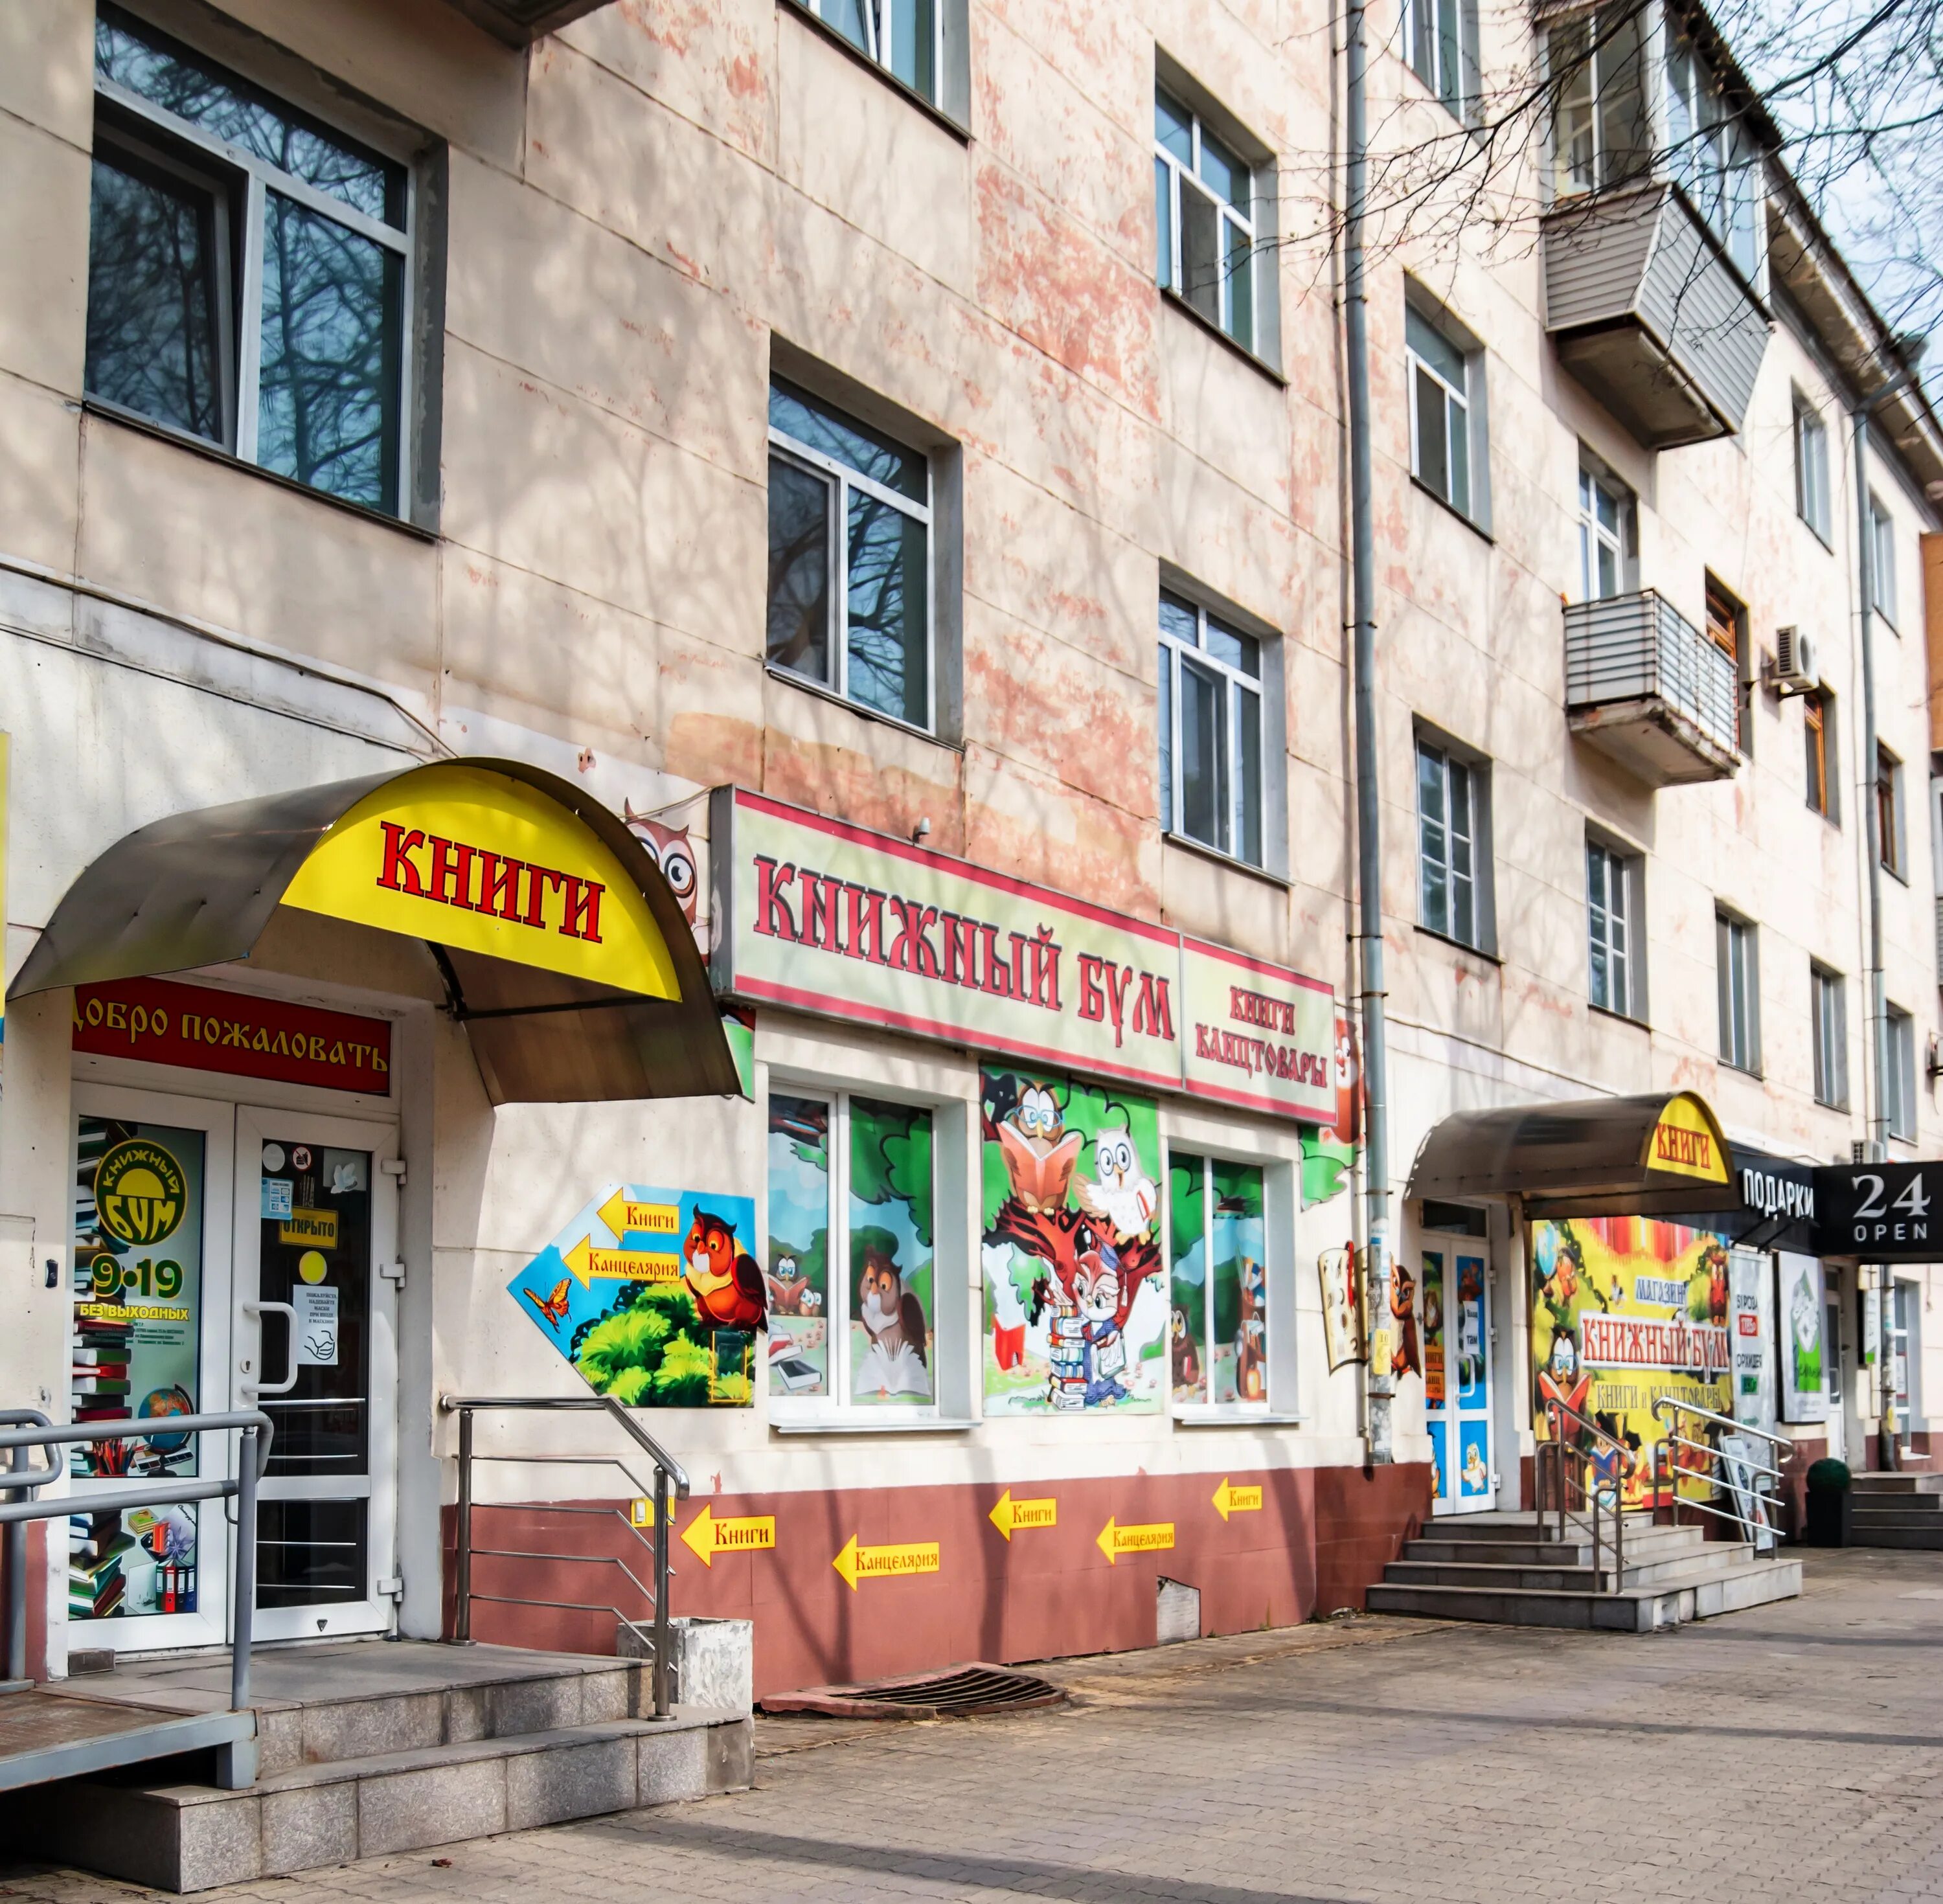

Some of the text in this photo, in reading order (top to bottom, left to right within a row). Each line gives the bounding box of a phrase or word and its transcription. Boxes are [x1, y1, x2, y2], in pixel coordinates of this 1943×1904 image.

[376, 821, 606, 944] КНИГИ
[1077, 952, 1176, 1048] БУМ
[1229, 984, 1295, 1036] КНИГИ
[1195, 1022, 1327, 1089] КАНЦТОВАРЫ
[1657, 1122, 1710, 1169] КНИГИ
[103, 1149, 181, 1194] КНИЖНЫЙ
[1743, 1168, 1813, 1221] ПОДАРКИ
[1852, 1172, 1931, 1219] 24
[105, 1195, 176, 1241] БУМ
[283, 1218, 335, 1238] ОТКРЫТО
[626, 1205, 674, 1229] Книги
[1854, 1223, 1927, 1242] OPEN
[588, 1252, 679, 1280] Канцелярия
[80, 1304, 190, 1320] БЕЗ ВЫХОДНЫХ
[1583, 1319, 1729, 1380] КНИЖНЫЙ БУМ
[1596, 1385, 1638, 1409] КНИГИ
[1229, 1490, 1259, 1506] Книги
[1012, 1504, 1052, 1524] Книги
[714, 1523, 769, 1546] Книги
[1113, 1530, 1174, 1550] Канцелярия
[855, 1551, 938, 1574] Канцелярия
